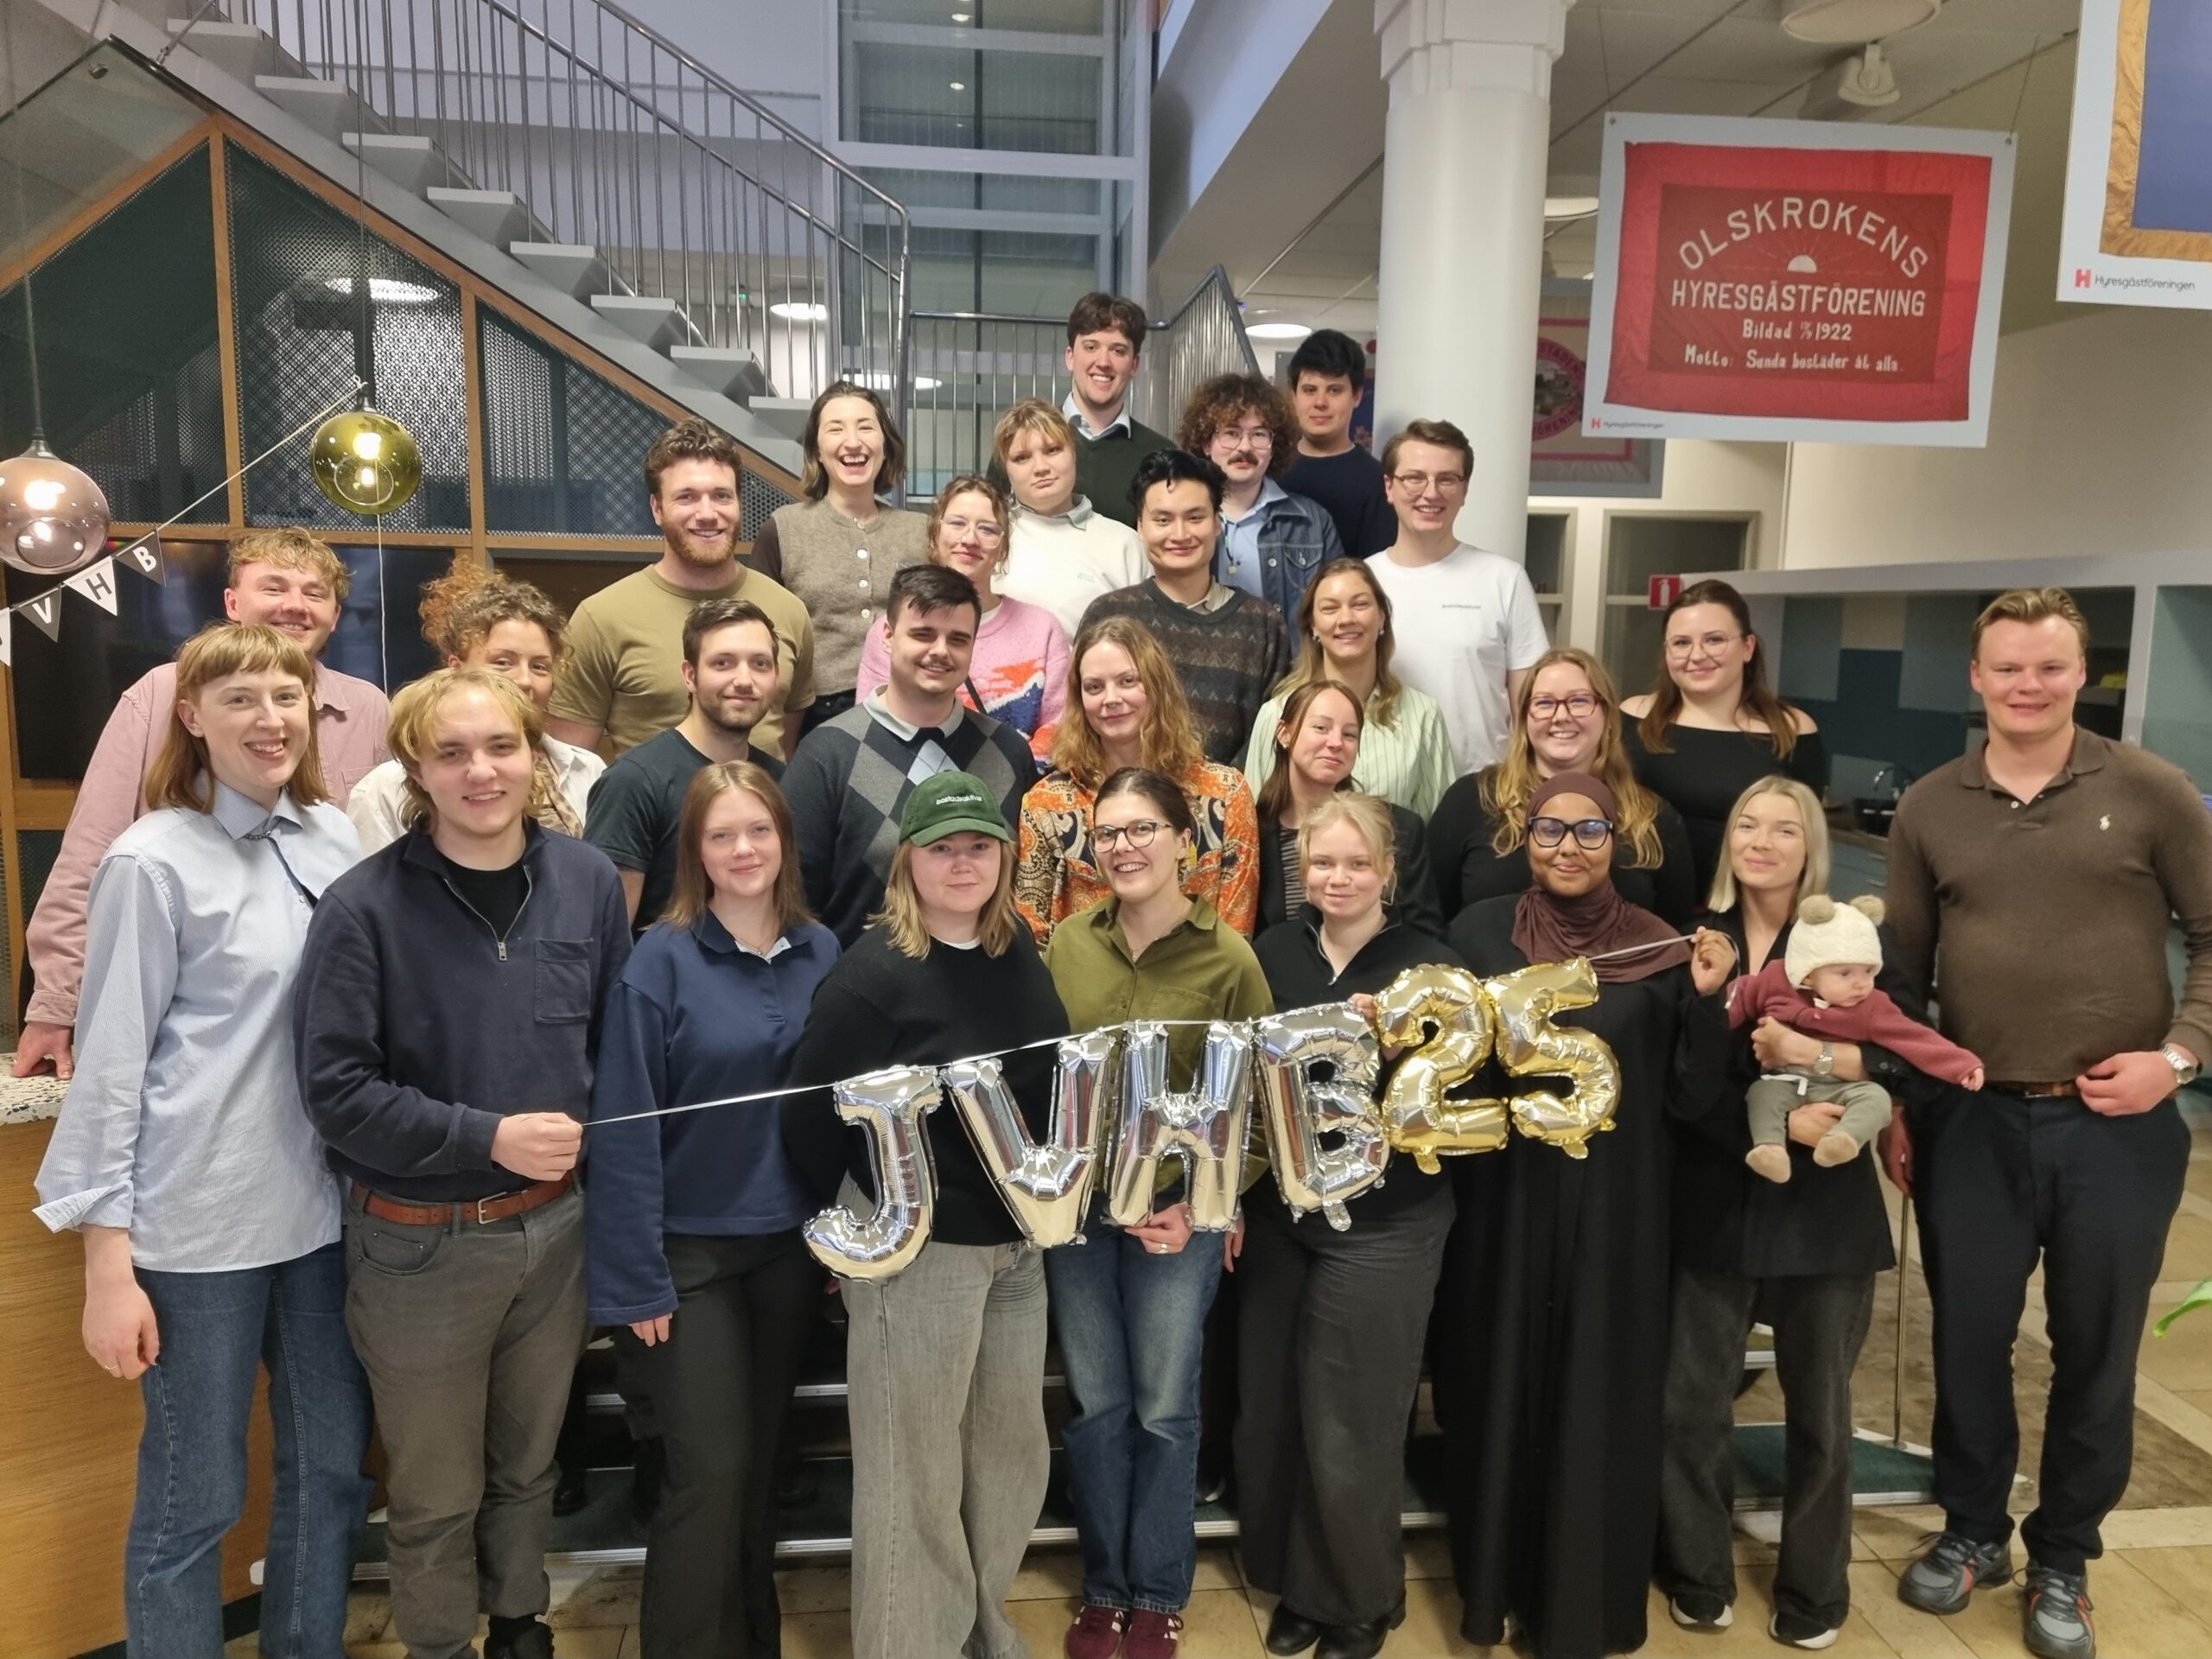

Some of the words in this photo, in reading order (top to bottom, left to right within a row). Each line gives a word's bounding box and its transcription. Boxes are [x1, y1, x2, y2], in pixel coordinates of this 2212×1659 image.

[1679, 197, 1929, 279] OLSKROKENS
[2094, 275, 2196, 292] Hyresgästföreningen
[1671, 279, 1926, 318] HYRESGÄSTFÖRENING
[1742, 318, 1793, 340] Bildad
[1745, 348, 1787, 370] Sunda
